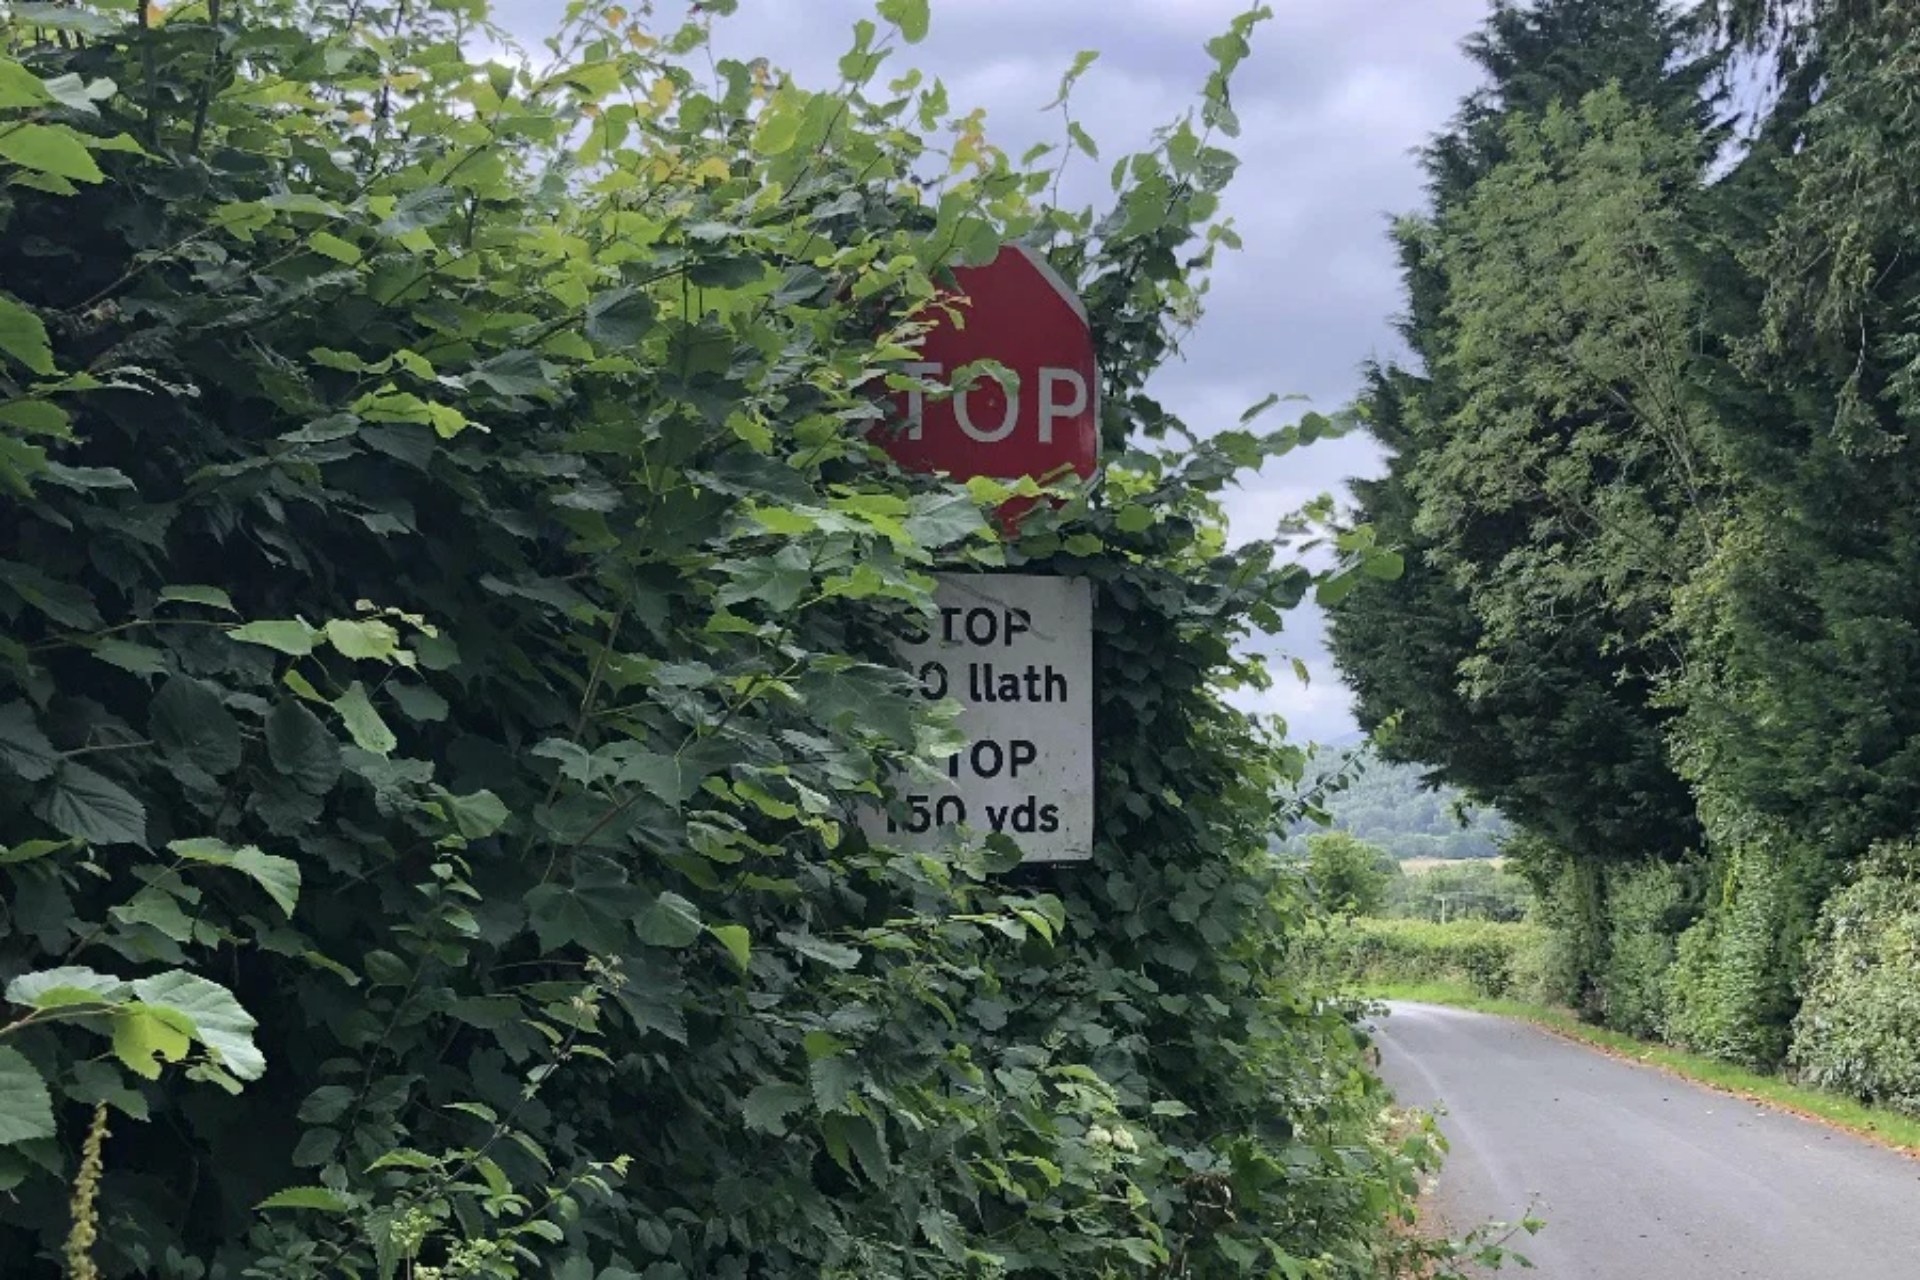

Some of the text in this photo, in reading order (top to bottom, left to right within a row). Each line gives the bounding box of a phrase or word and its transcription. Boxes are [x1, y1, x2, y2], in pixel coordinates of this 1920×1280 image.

[893, 361, 1088, 443] TOP
[968, 662, 1067, 702] llath
[942, 739, 1037, 778] TOP
